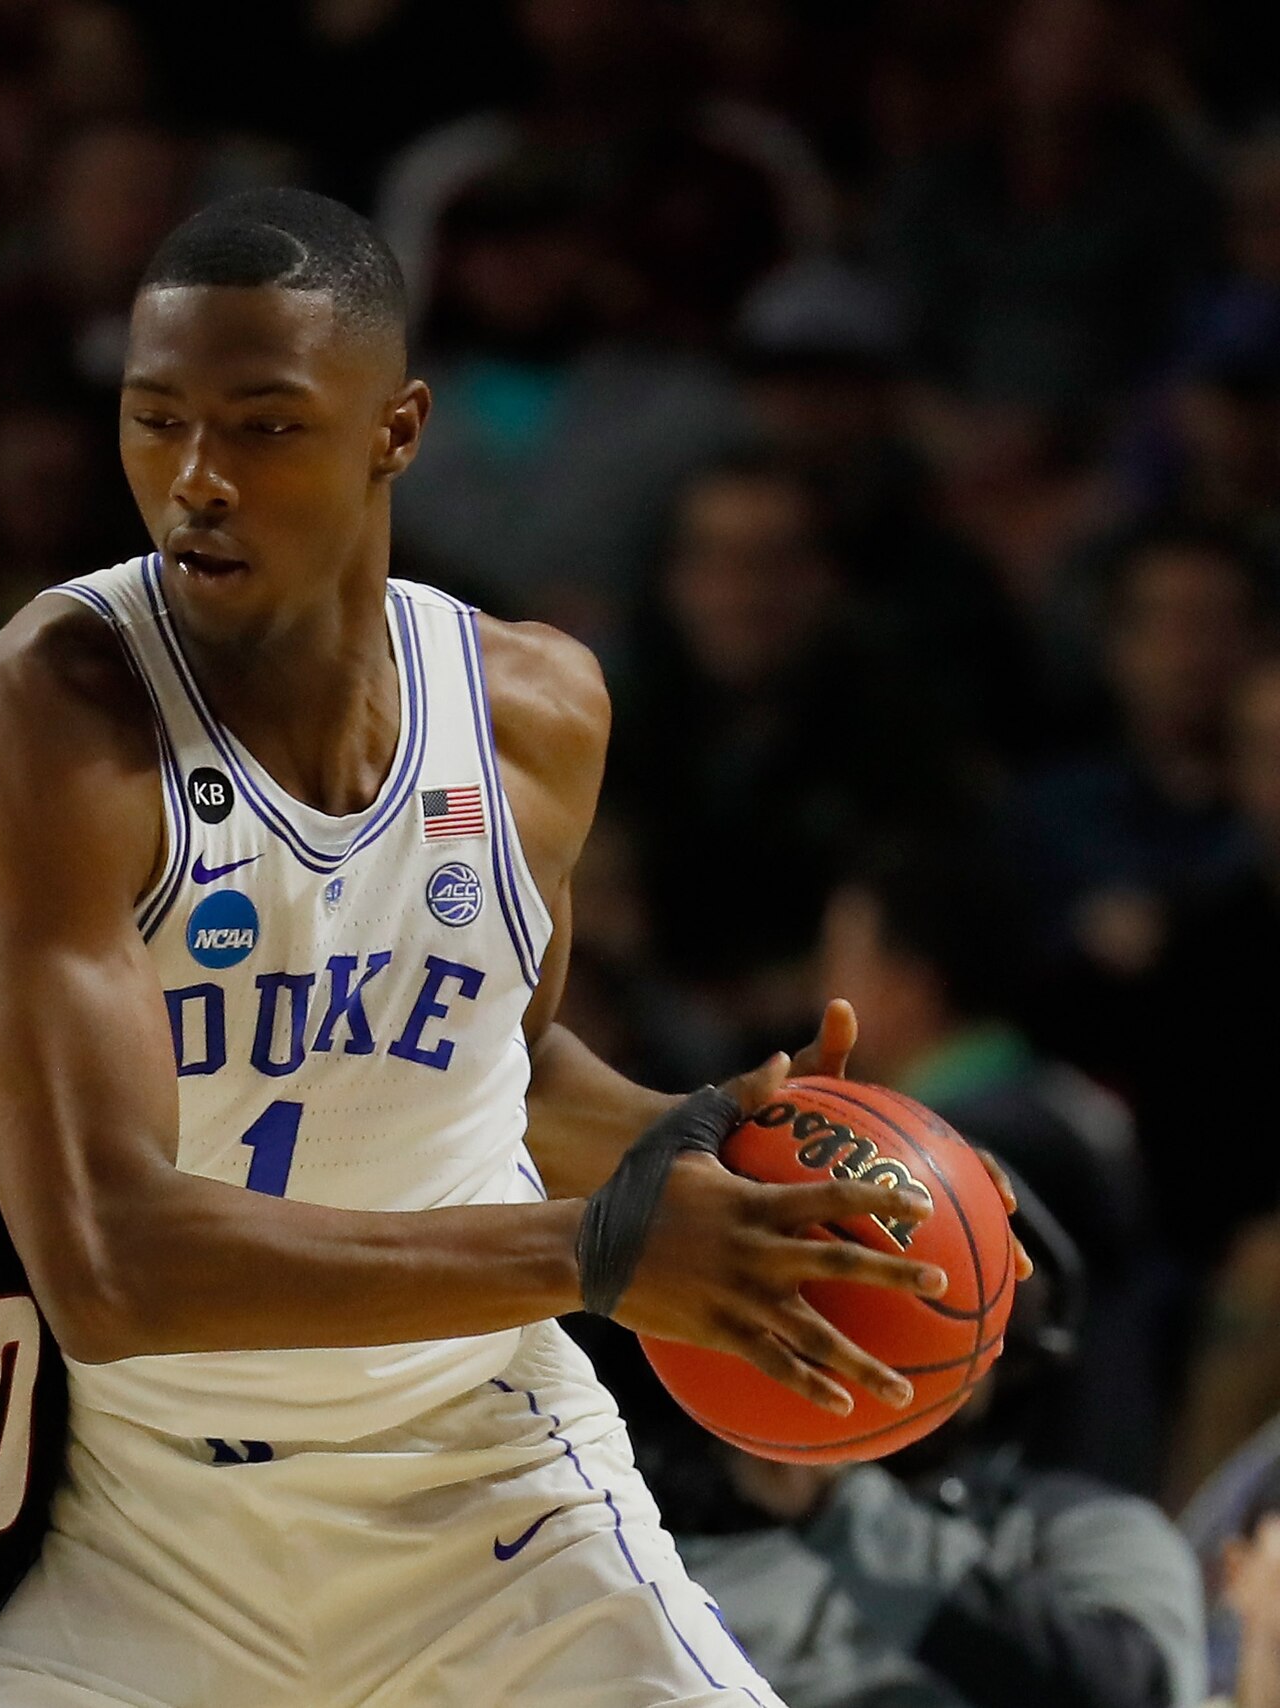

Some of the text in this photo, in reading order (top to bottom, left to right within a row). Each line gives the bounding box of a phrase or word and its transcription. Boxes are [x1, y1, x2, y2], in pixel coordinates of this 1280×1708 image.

[193, 782, 225, 806] KB
[436, 883, 478, 897] ACC
[193, 928, 254, 949] NCAA
[163, 951, 486, 1077] DUKE
[241, 1100, 303, 1197] 1
